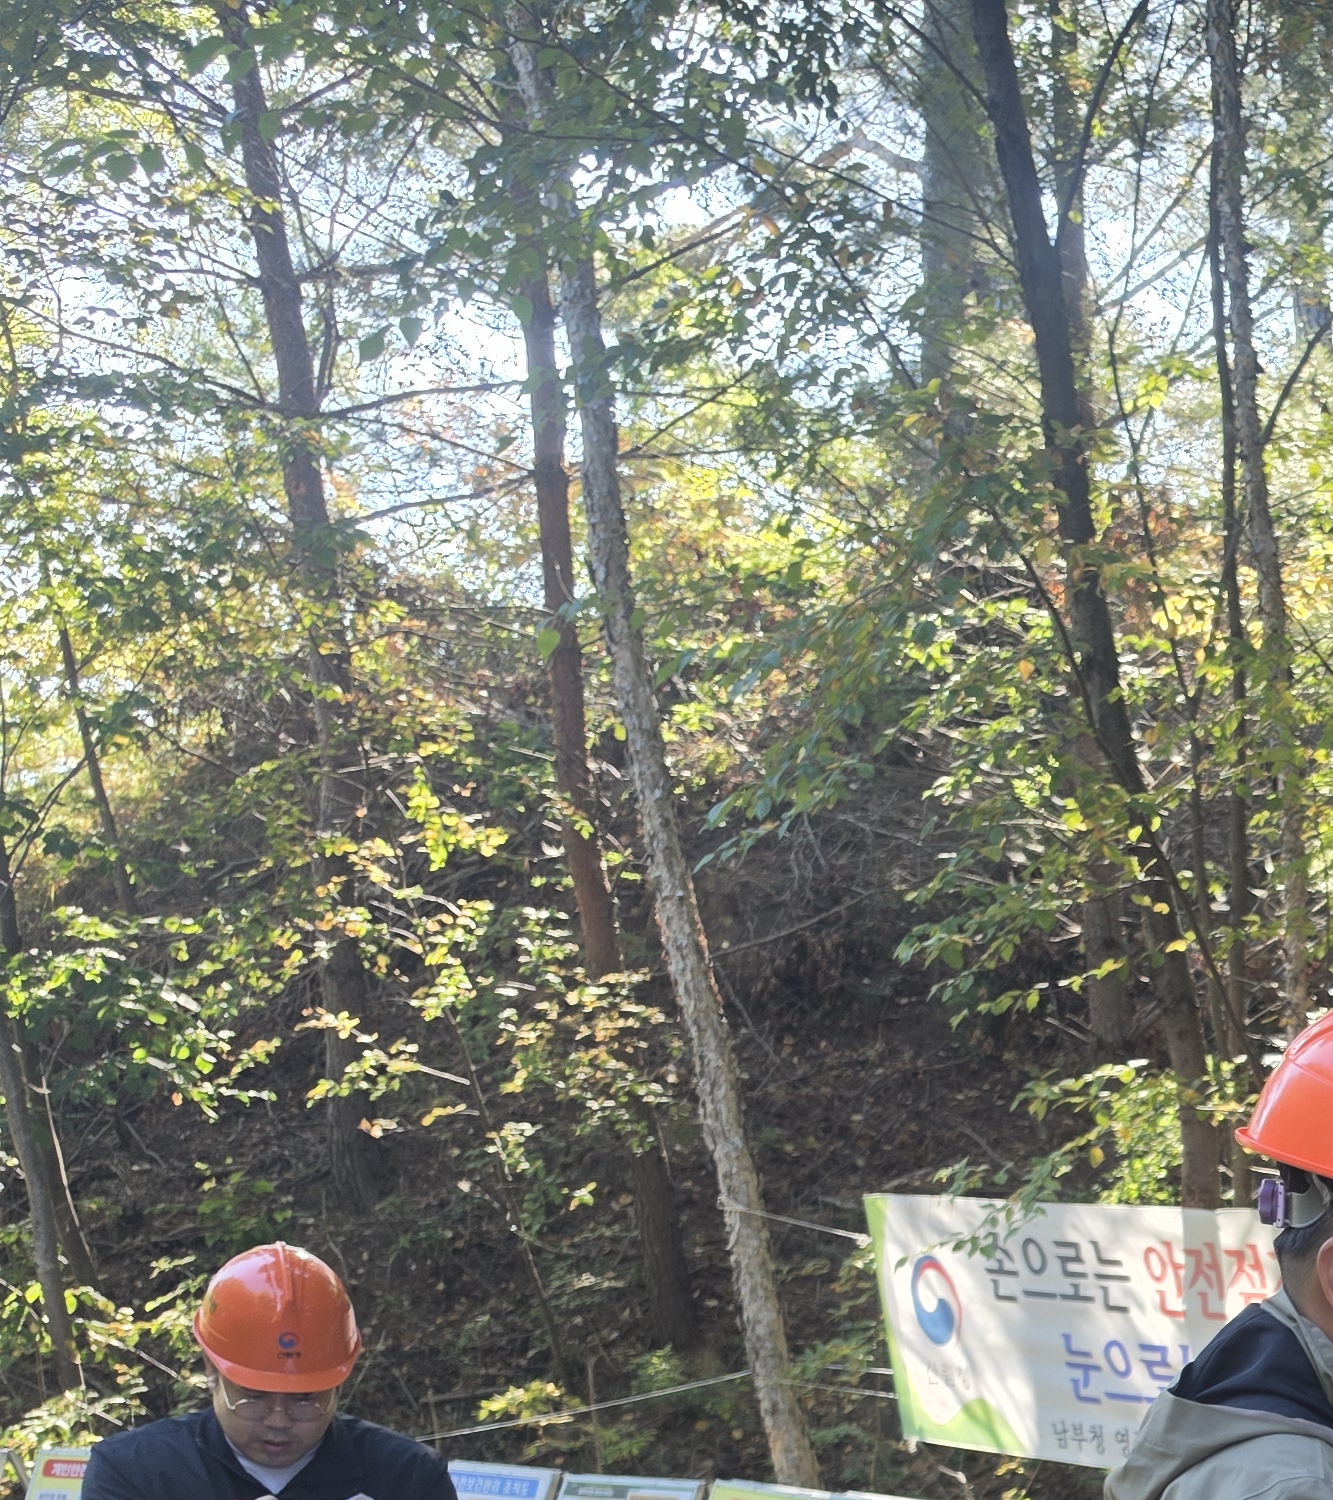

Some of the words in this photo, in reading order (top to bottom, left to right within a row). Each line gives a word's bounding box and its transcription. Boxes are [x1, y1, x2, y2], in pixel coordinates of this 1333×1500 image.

[984, 1232, 1132, 1314] 손으로는
[1143, 1239, 1284, 1322] 안전점
[1060, 1333, 1193, 1405] 눈으로
[1051, 1420, 1106, 1456] 남부청
